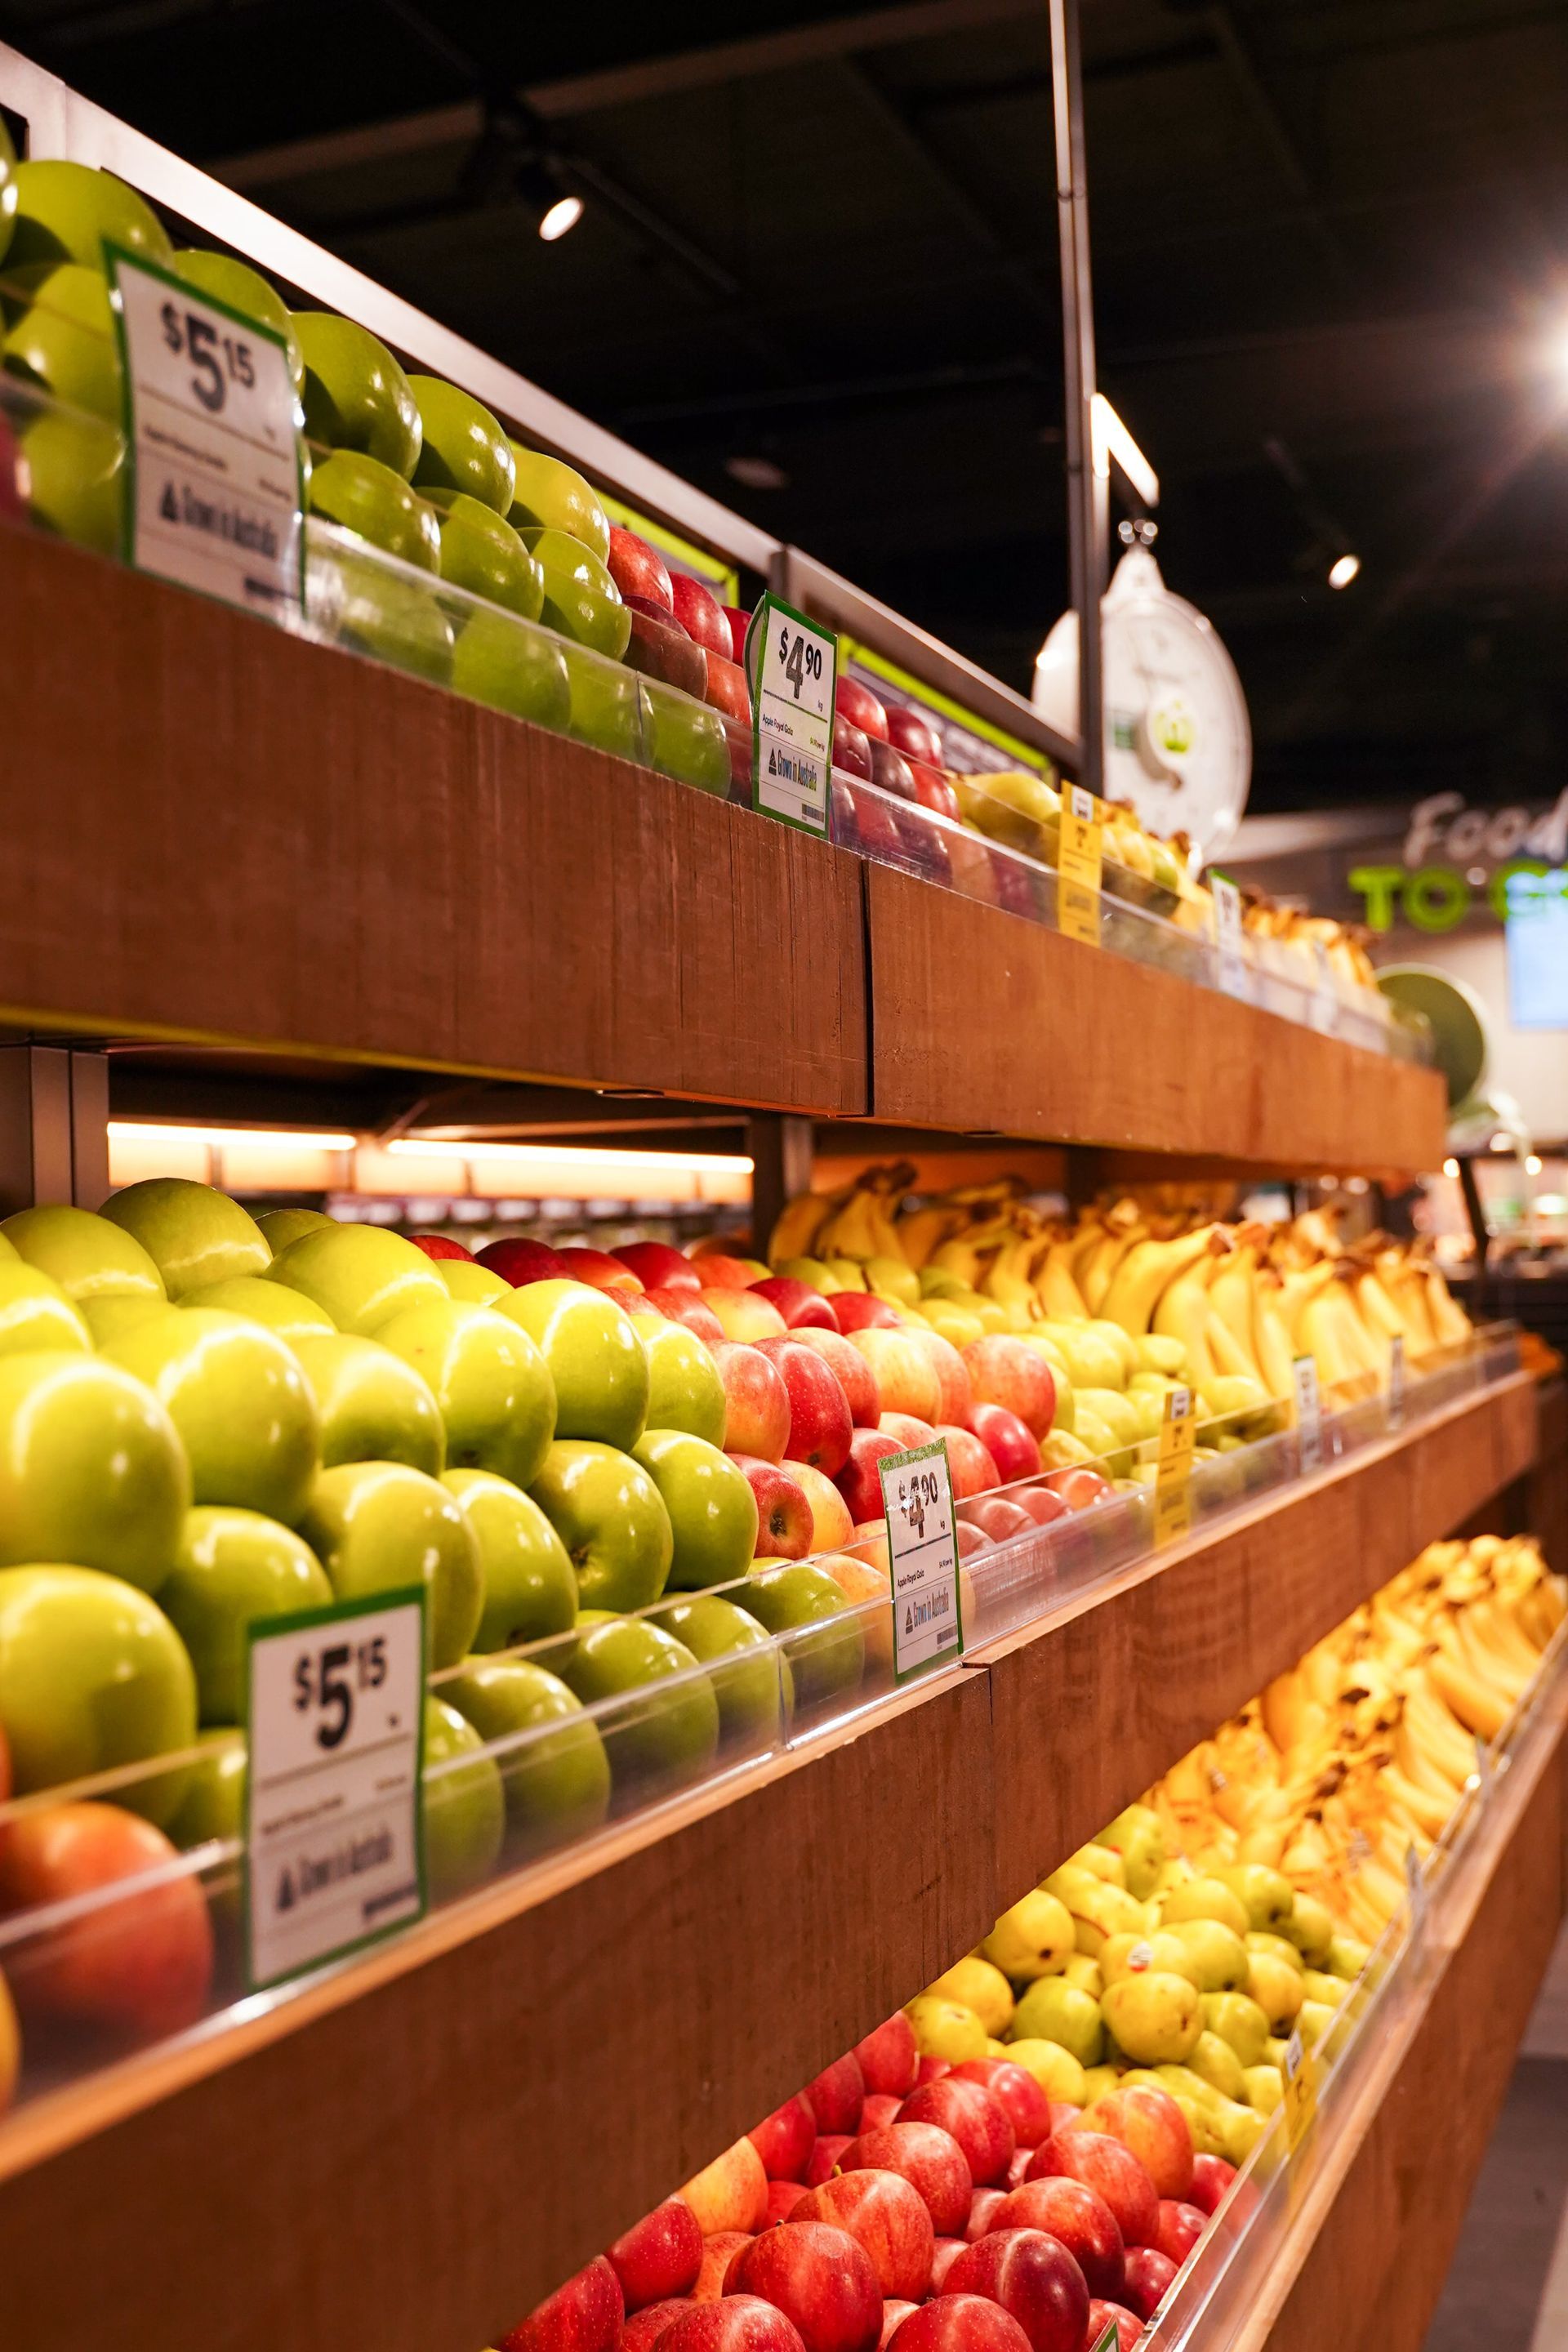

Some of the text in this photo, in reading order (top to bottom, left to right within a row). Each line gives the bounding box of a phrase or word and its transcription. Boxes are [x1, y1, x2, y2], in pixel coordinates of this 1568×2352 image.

[763, 714, 794, 736] Apple Royal Gala
[778, 749, 817, 791] Grown in Australia
[1349, 866, 1468, 933] TO
[898, 1569, 924, 1589] Apple Royal Gala
[914, 1587, 949, 1627] Grown in Australia
